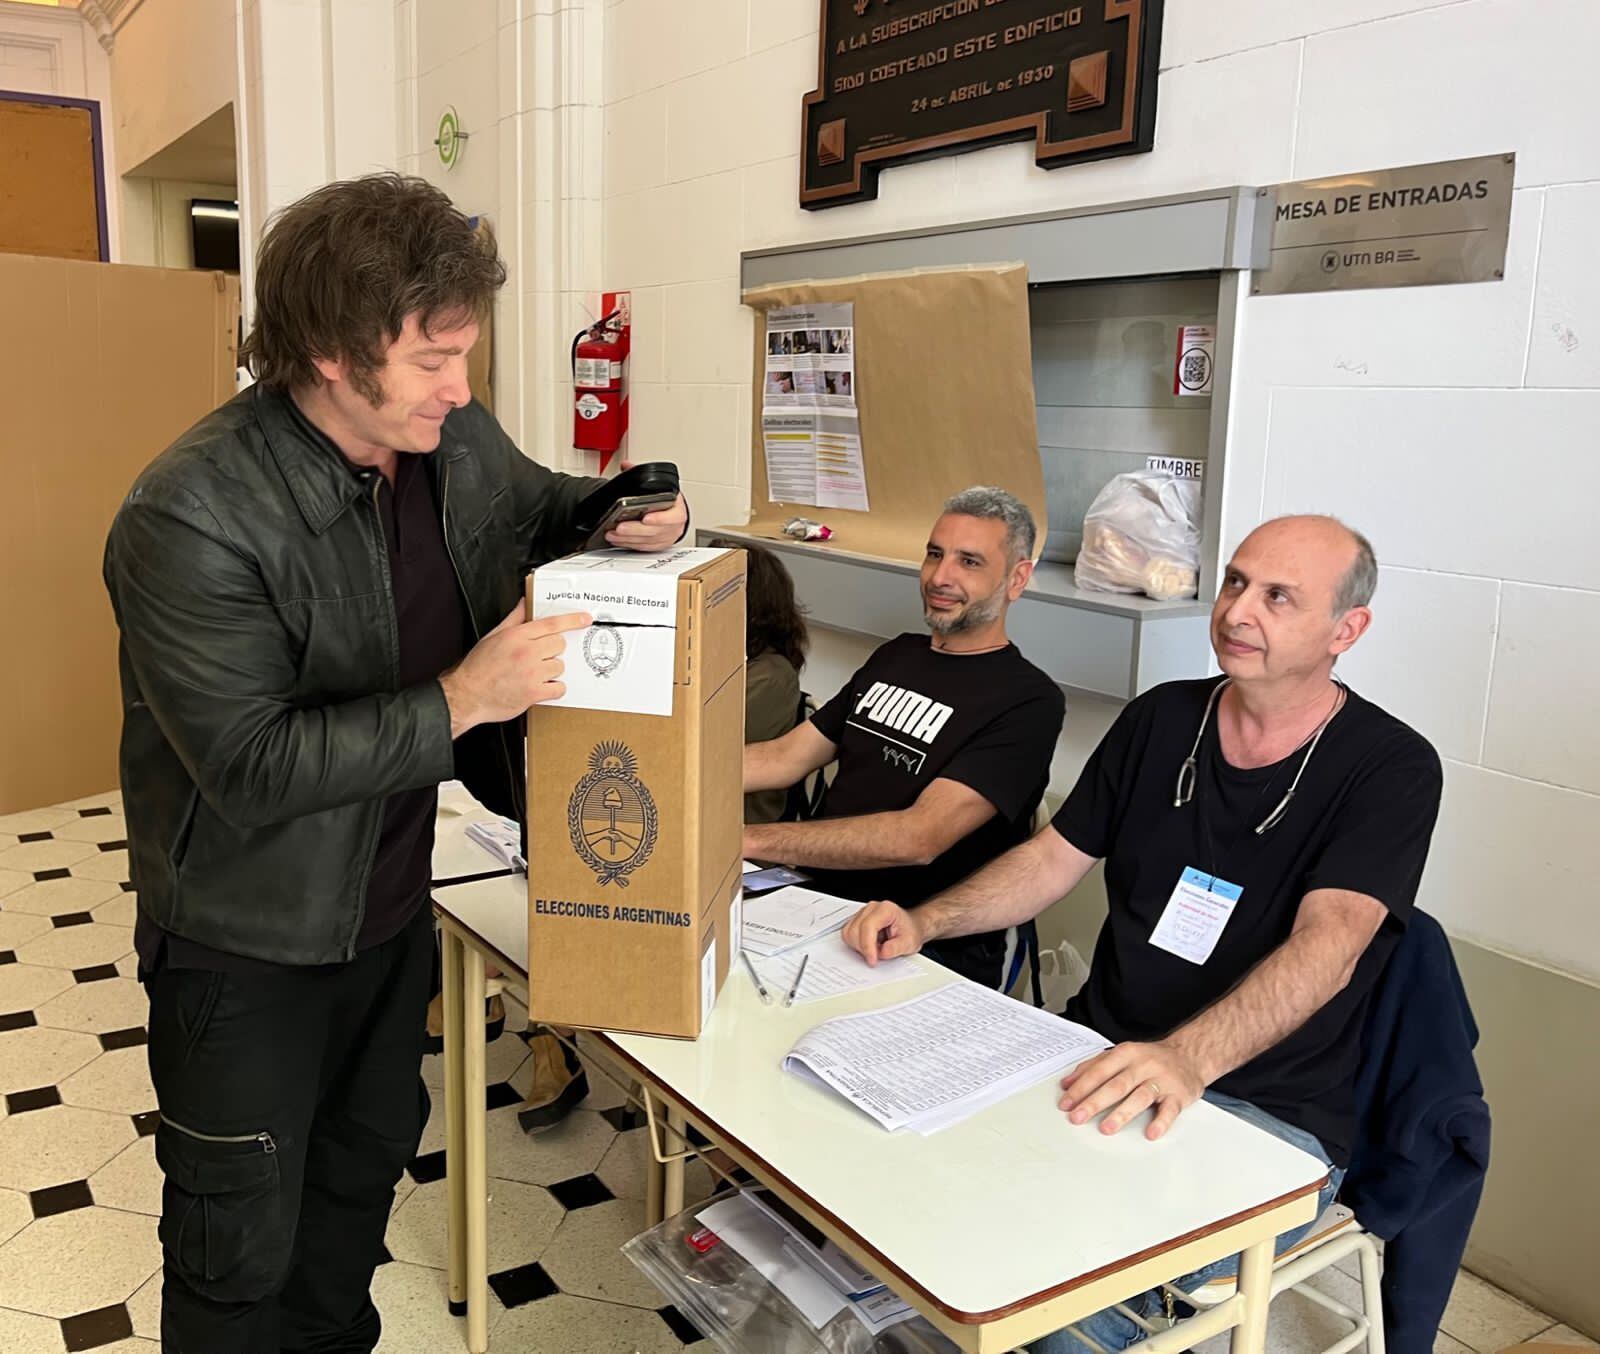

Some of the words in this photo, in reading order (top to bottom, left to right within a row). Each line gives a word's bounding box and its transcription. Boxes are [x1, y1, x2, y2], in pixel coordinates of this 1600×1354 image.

[836, 40, 847, 54] A
[849, 33, 868, 50] LA
[871, 0, 979, 43] SUBSCRIPCION
[834, 71, 865, 93] SIDO
[869, 47, 948, 84] COSTEADO
[953, 32, 998, 59] ESTE
[1003, 7, 1083, 45] EDIFICIO
[911, 97, 929, 113] 24
[948, 80, 993, 104] ABRIL
[1017, 65, 1055, 86] 1930
[1275, 200, 1327, 221] MESA
[1334, 195, 1361, 214] DE
[1367, 180, 1489, 211] ENTRADAS
[1147, 458, 1202, 478] TIMBRE
[583, 592, 625, 605] Nacional
[627, 595, 670, 608] Electoral
[855, 681, 954, 744] PUMA
[535, 899, 610, 920] ELECCIONES
[612, 905, 691, 928] ARGENTINAS
